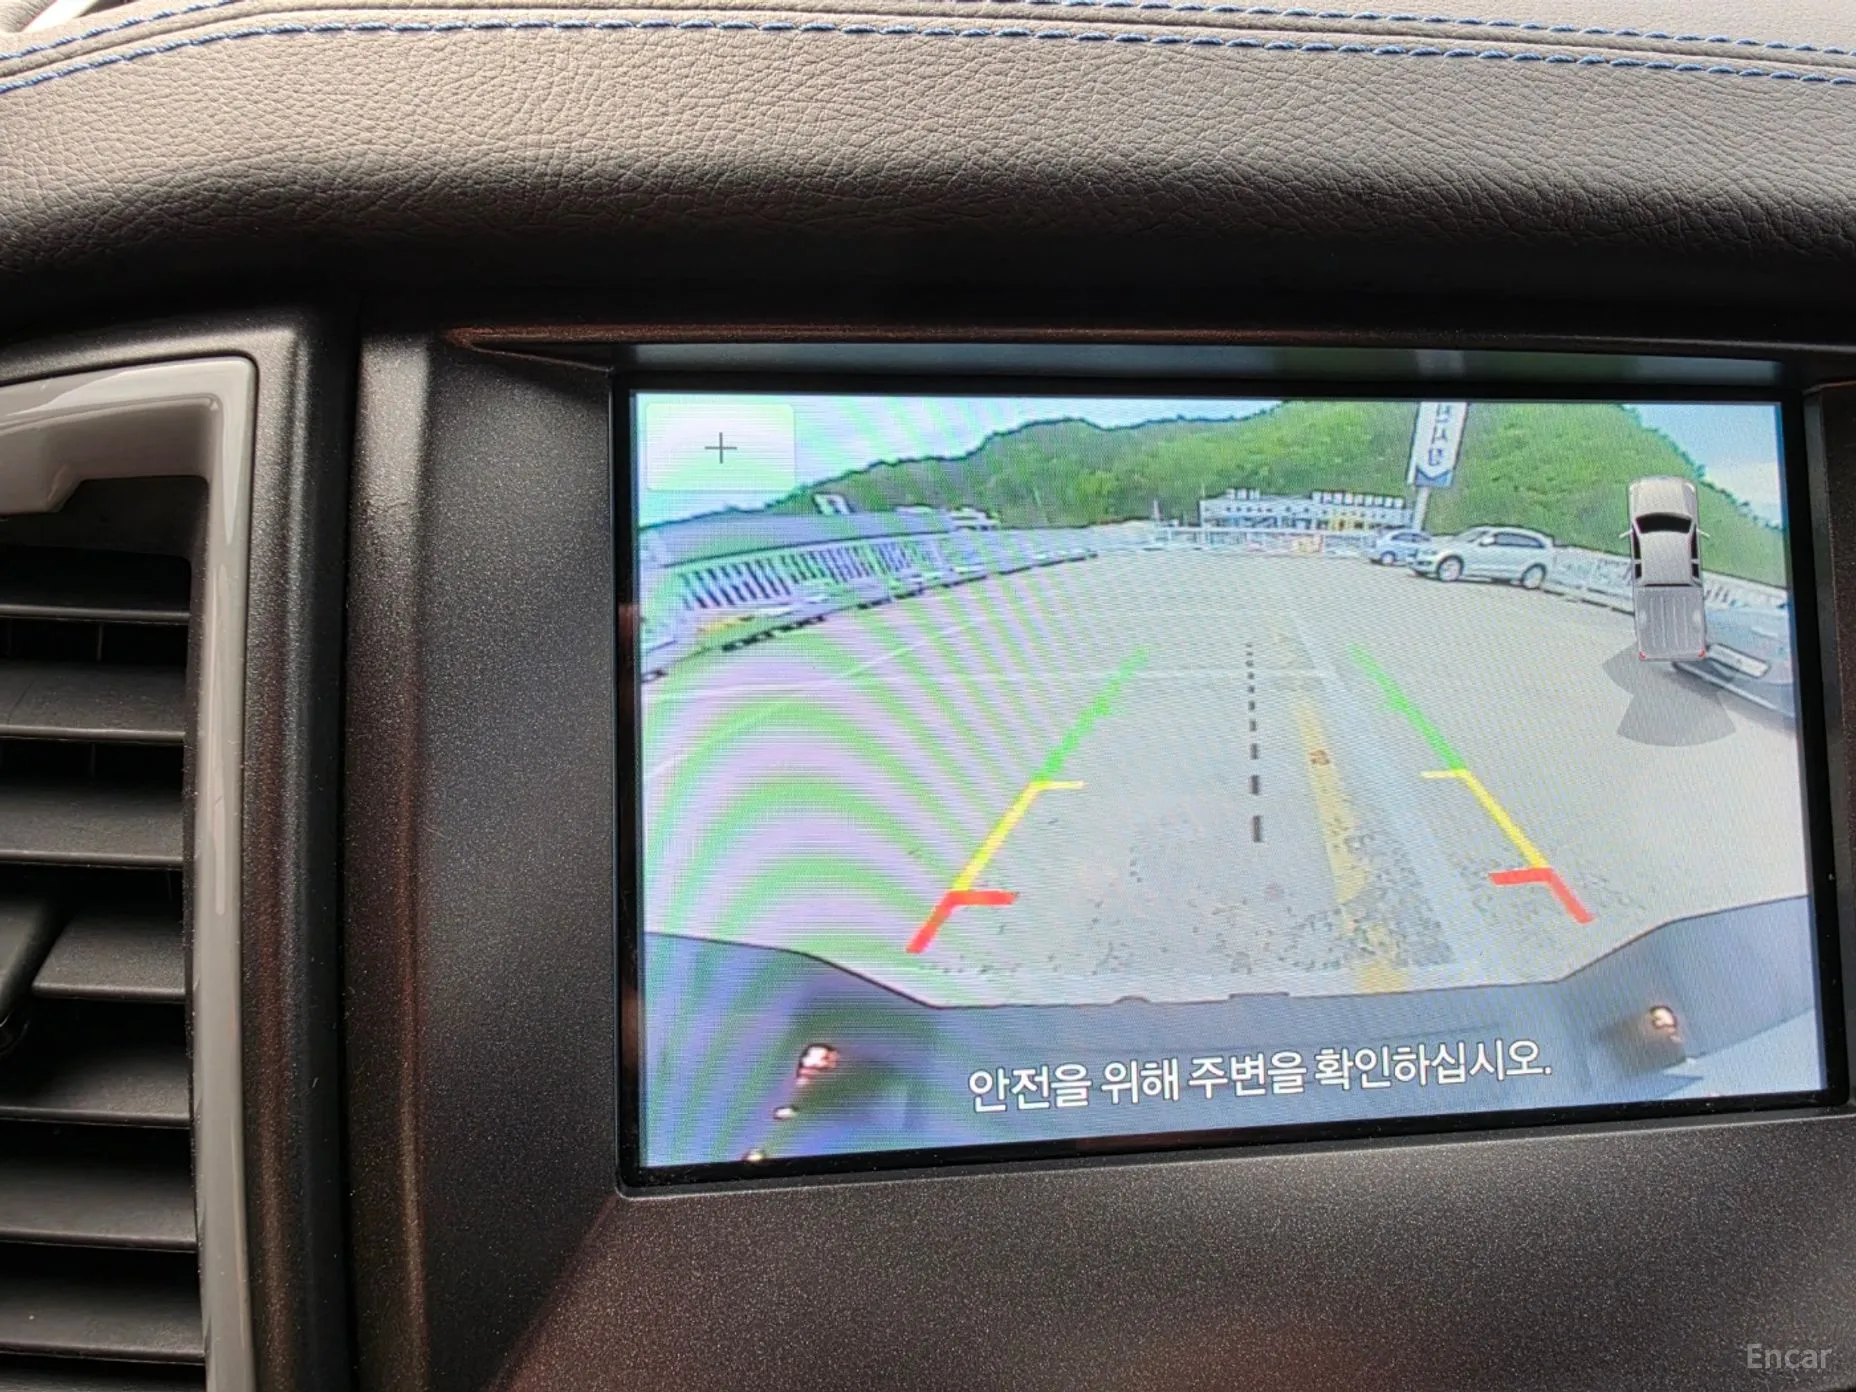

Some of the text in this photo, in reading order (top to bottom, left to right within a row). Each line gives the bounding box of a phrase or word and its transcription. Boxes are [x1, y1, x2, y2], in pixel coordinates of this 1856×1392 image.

[968, 1038, 1553, 1113] 안전을 위해 주변을 확인하십시오.
